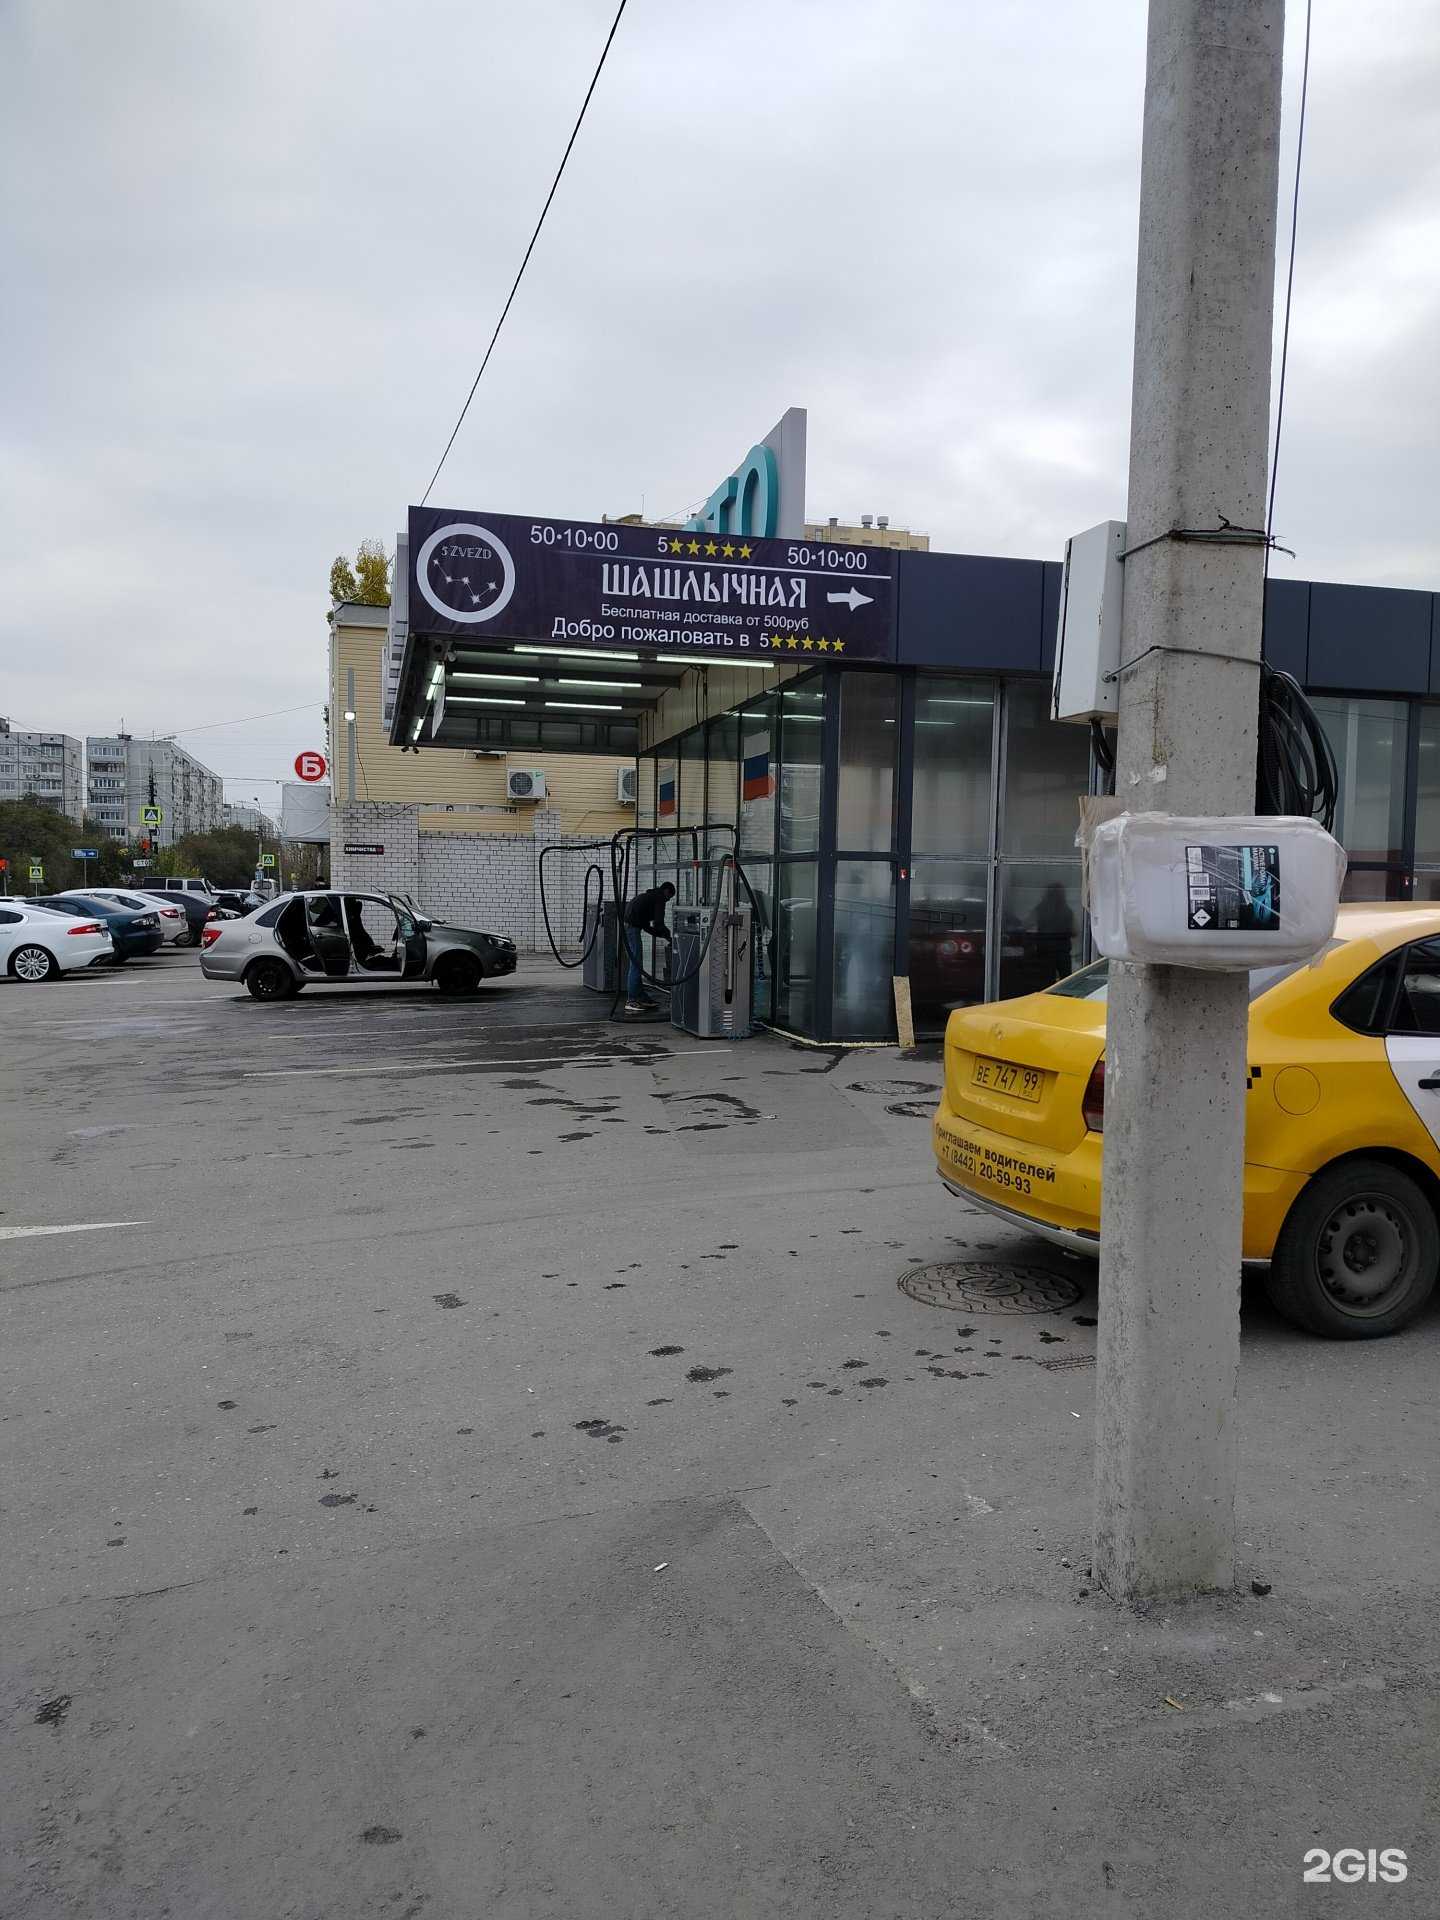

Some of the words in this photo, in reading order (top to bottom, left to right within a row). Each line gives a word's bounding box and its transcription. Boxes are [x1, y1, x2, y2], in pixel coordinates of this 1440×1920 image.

[450, 545, 492, 559] ZVEZD
[602, 562, 807, 609] ШАШЛЫЧНАЯ
[551, 616, 615, 641] Добро
[621, 626, 734, 646] пожаловать
[740, 634, 750, 647] в
[601, 603, 680, 621] Бесплатная
[683, 612, 743, 625] доставка
[746, 616, 760, 626] от
[764, 615, 809, 632] 500руб
[302, 756, 321, 777] Б
[993, 1064, 1017, 1091] 747
[1024, 1072, 1038, 1091] 99
[951, 1149, 977, 1176] (8442)
[979, 1162, 1031, 1194] 20-59-93
[984, 1148, 1056, 1183] водителей
